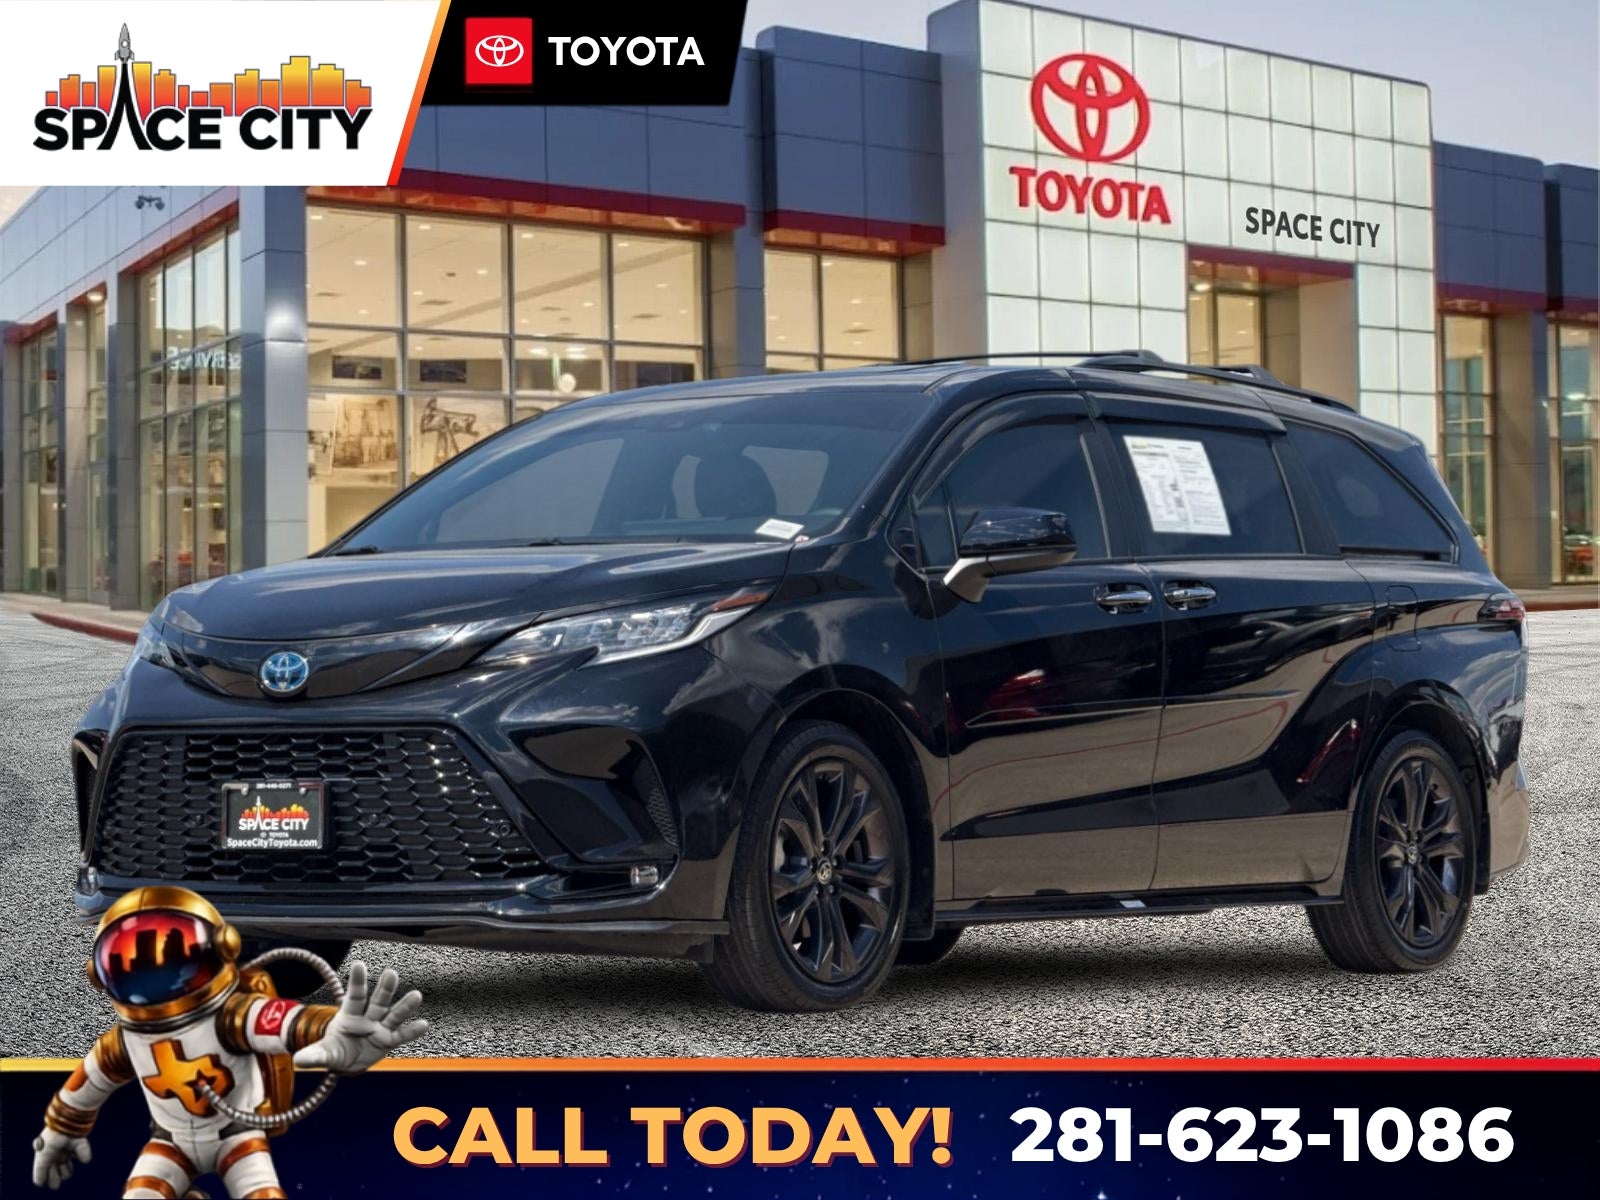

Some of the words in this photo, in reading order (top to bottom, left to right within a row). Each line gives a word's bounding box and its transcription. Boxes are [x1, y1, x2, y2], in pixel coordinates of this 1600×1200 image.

[1009, 166, 1171, 224] TOYOTA
[1245, 206, 1323, 242] SPACE
[1329, 218, 1381, 249] CITY
[239, 817, 279, 830] SPACE
[281, 818, 309, 830] CITY
[227, 838, 318, 849] SpaceCityToyota.com
